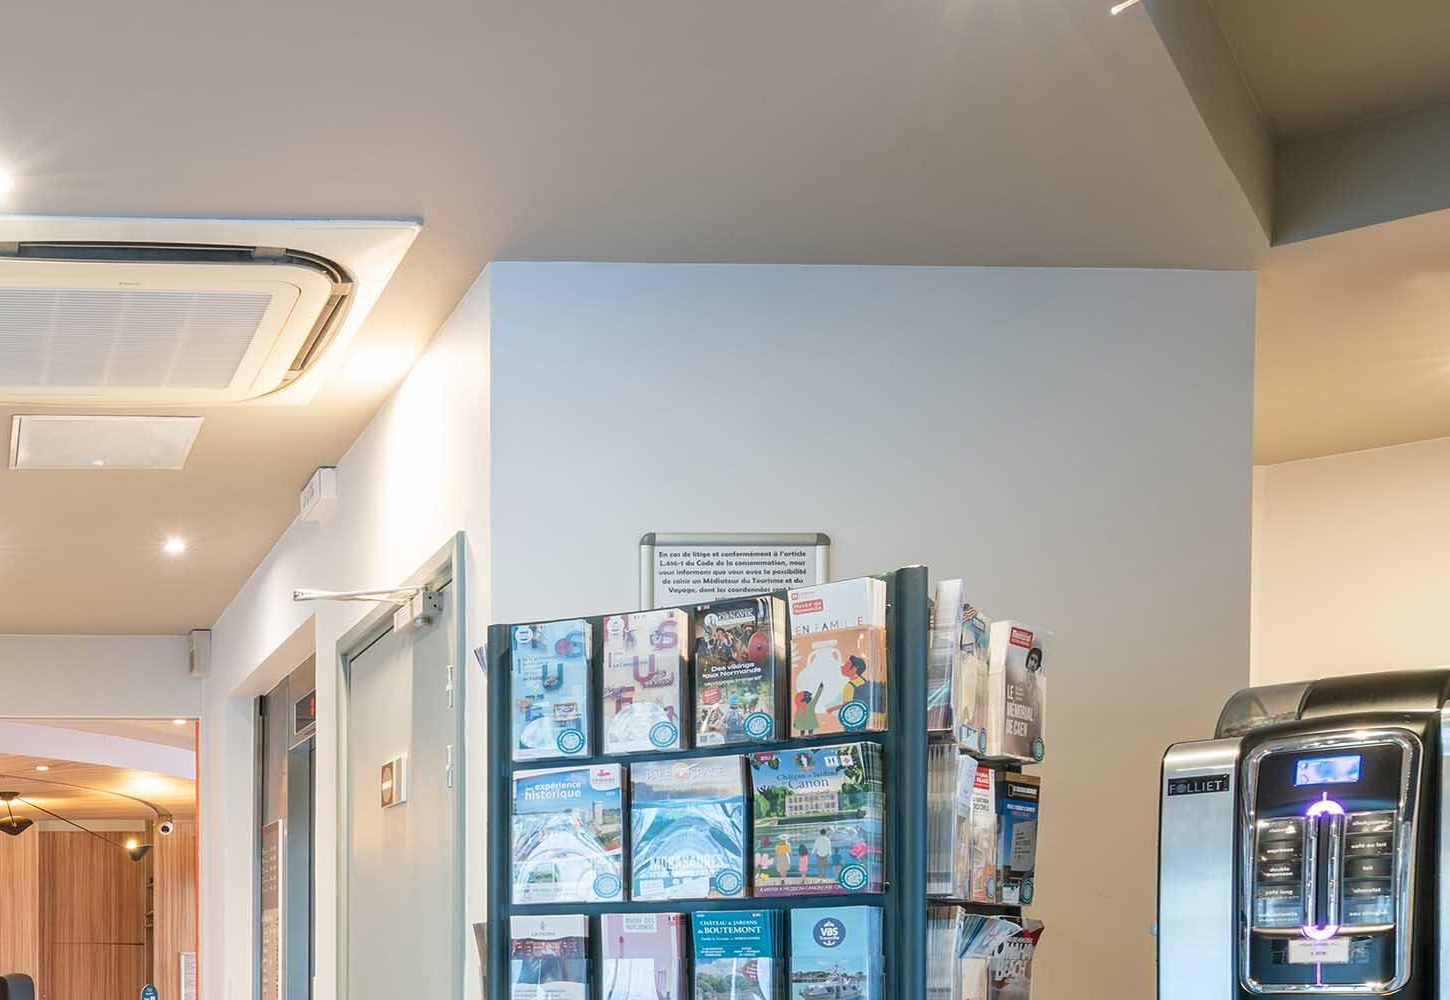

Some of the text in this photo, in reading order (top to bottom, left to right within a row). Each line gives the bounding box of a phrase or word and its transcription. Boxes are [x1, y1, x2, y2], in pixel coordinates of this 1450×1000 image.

[668, 586, 697, 594] Voyage,
[698, 586, 715, 594] dont
[716, 586, 726, 594] les
[727, 586, 770, 594] coordonnées
[534, 781, 582, 793] expérience
[788, 778, 830, 790] Canon
[1169, 780, 1222, 795] FOLLIET
[524, 788, 582, 802] historique
[704, 926, 762, 934] BOUTEMONT
[820, 926, 839, 936] VBS
